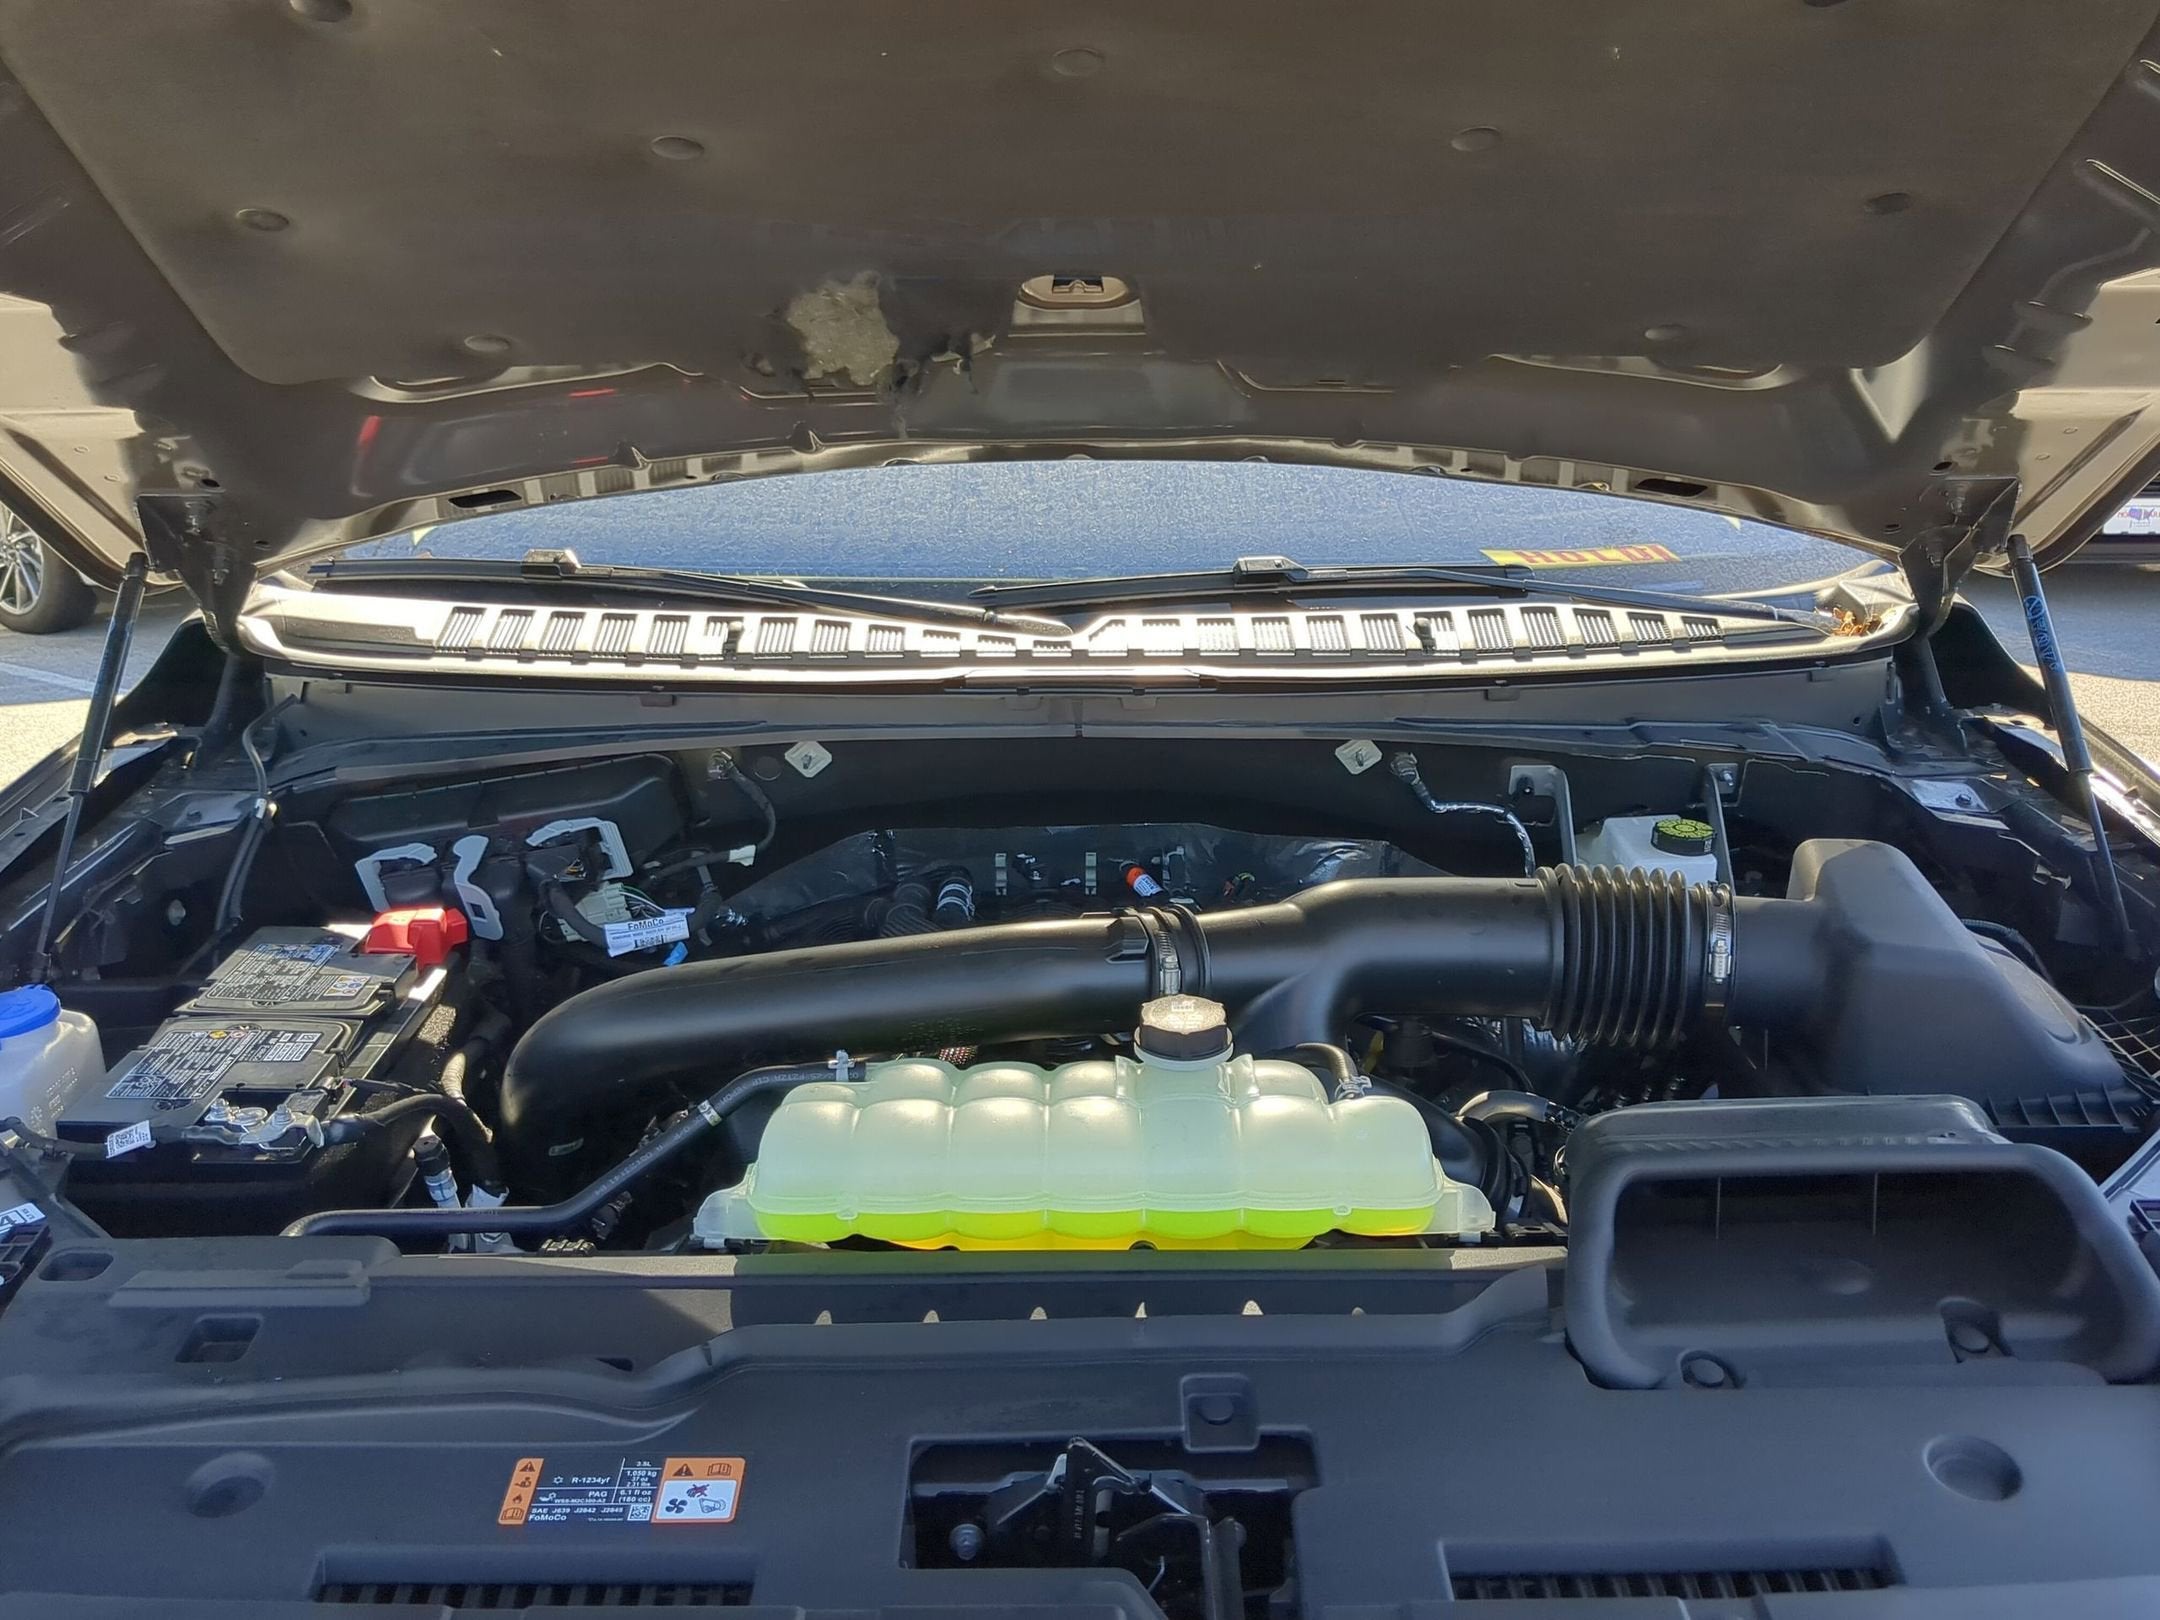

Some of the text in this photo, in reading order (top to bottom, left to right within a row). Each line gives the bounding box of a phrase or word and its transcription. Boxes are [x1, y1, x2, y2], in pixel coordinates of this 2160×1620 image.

[627, 918, 664, 931] FoMoCo
[647, 1470, 657, 1478] kg
[571, 1477, 611, 1485] R-1234yf
